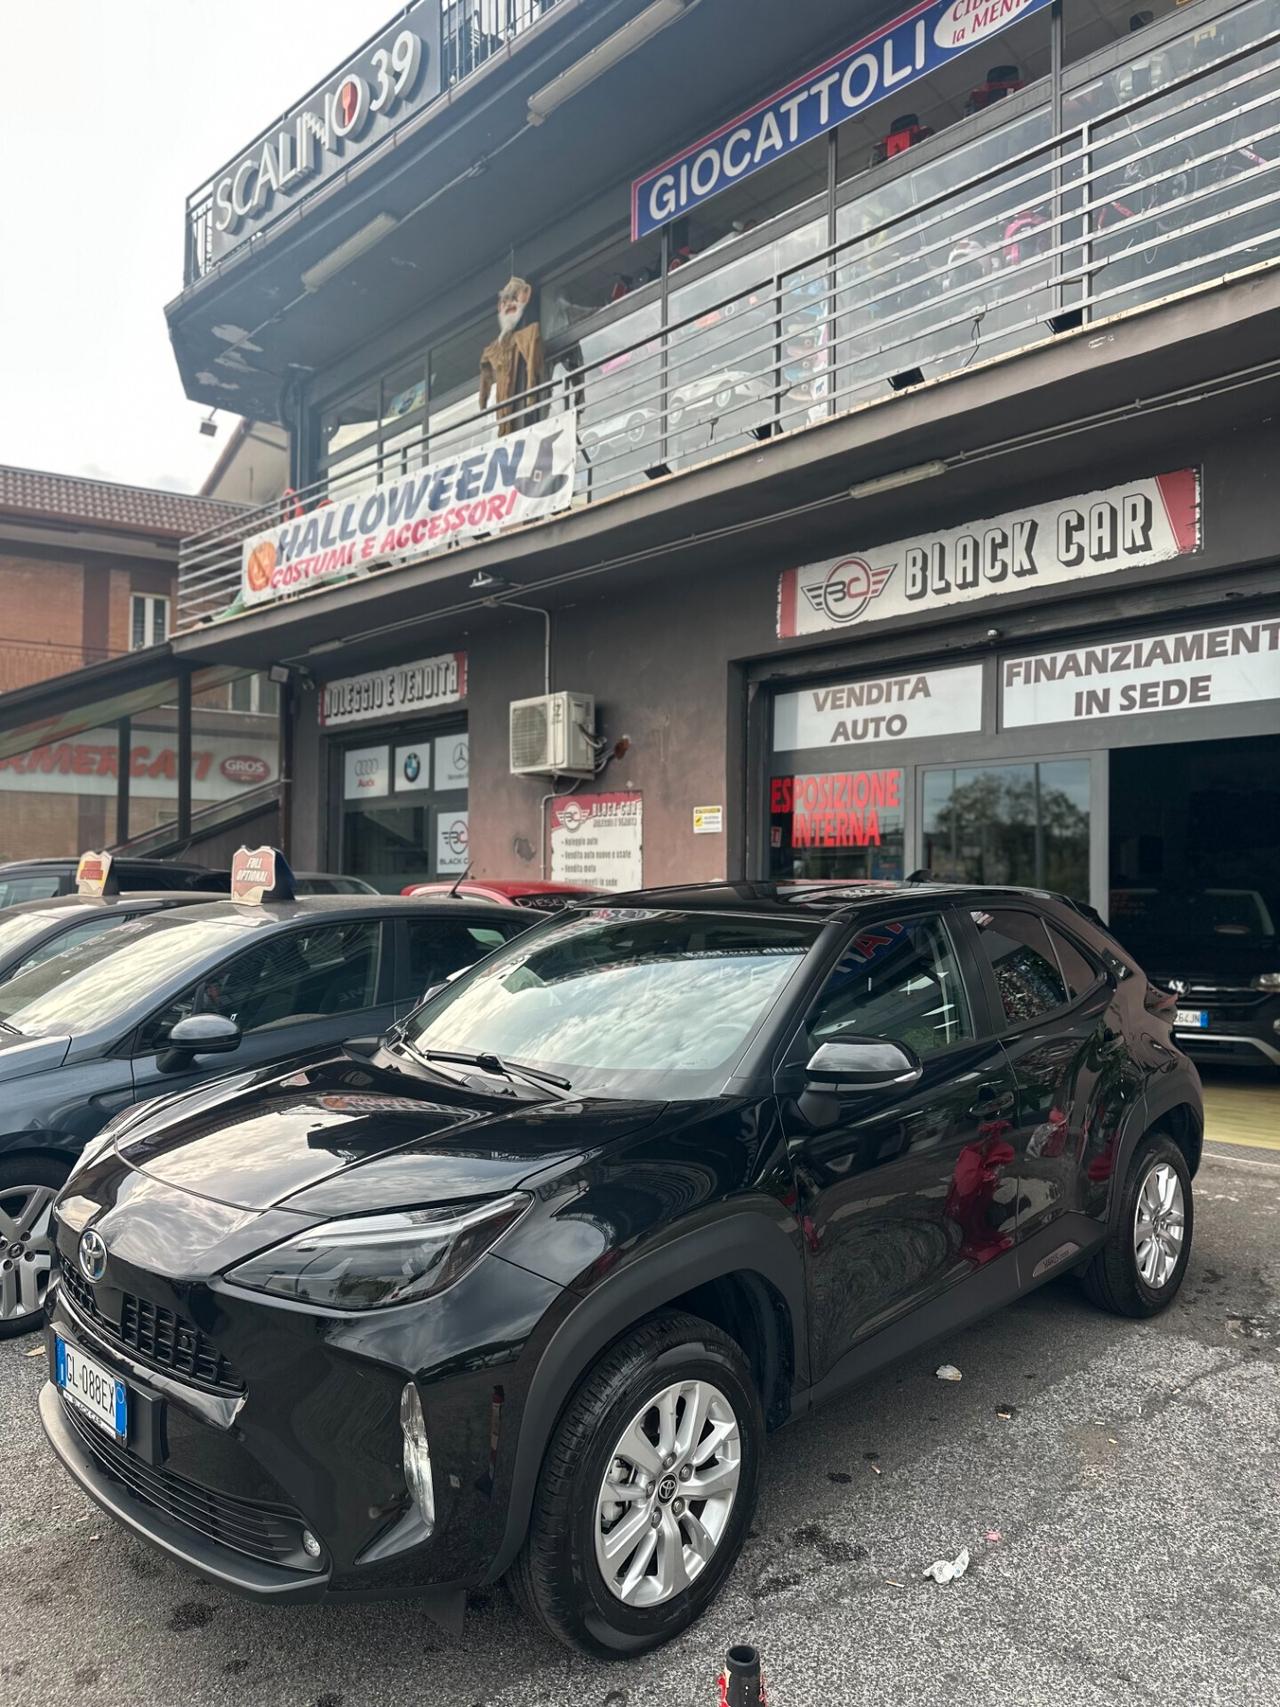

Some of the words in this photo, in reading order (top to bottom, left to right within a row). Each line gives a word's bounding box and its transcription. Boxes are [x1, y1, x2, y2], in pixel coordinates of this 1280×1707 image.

[972, 0, 1029, 33] MEN
[214, 74, 370, 233] SCALINO
[369, 29, 422, 116] 39
[648, 20, 926, 221] GIOCATTOLI
[274, 438, 525, 566] HALLOWEEN
[270, 543, 355, 589] COSTUMI
[360, 537, 375, 558] E
[380, 489, 520, 555] ACCESSORI
[904, 518, 1039, 602] BLACK
[1056, 493, 1153, 567] CAR
[1005, 621, 1280, 688] FINANZIAMENT
[324, 681, 385, 718] NOLEGGIO
[387, 673, 396, 706] E
[400, 660, 459, 703] VENDITA
[812, 676, 931, 712] VENDITA
[1074, 687, 1111, 717] IN
[1119, 675, 1212, 712] SEDE
[830, 713, 908, 743] AUTO
[224, 759, 265, 773] GROS
[770, 768, 901, 814] ESPOSIZIONE
[791, 808, 881, 848] INTERNA
[82, 1364, 115, 1417] 088EX
